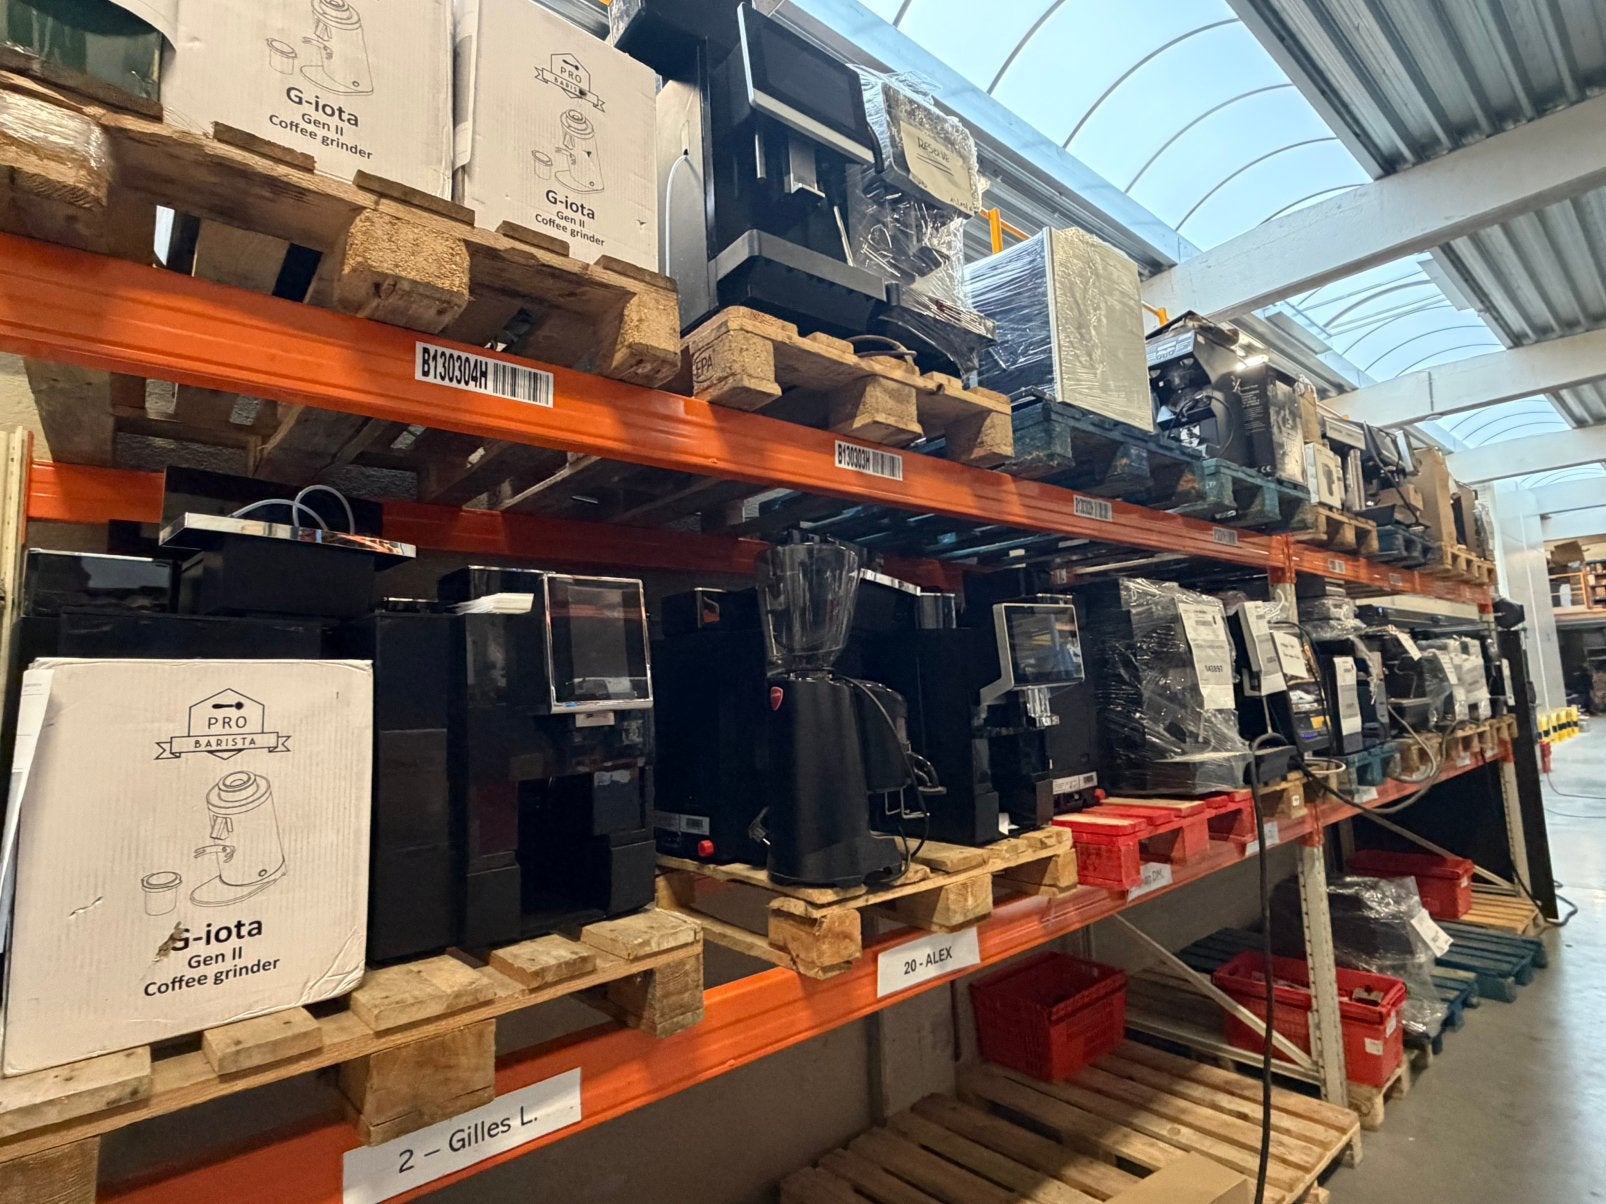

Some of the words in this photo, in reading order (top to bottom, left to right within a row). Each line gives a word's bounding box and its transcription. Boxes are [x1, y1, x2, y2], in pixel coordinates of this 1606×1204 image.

[560, 66, 582, 84] PRO
[286, 86, 359, 127] G-iota
[269, 114, 318, 140] Coffee
[321, 135, 373, 159] grinder
[301, 113, 330, 131] Gen
[545, 189, 595, 220] G-iota
[556, 210, 576, 226] Gen
[535, 213, 568, 233] Coffee
[570, 228, 605, 247] grinder
[421, 346, 489, 390] B130304H
[207, 715, 248, 730] PRO
[194, 736, 257, 749] BARISTA
[187, 951, 226, 969] Gen
[903, 958, 917, 975] 20
[925, 946, 953, 968] ALEX
[143, 974, 209, 997] Coffee
[212, 958, 281, 986] grinder
[397, 1149, 415, 1174] 2
[448, 1117, 512, 1153] Gilles
[519, 1105, 538, 1127] L.
